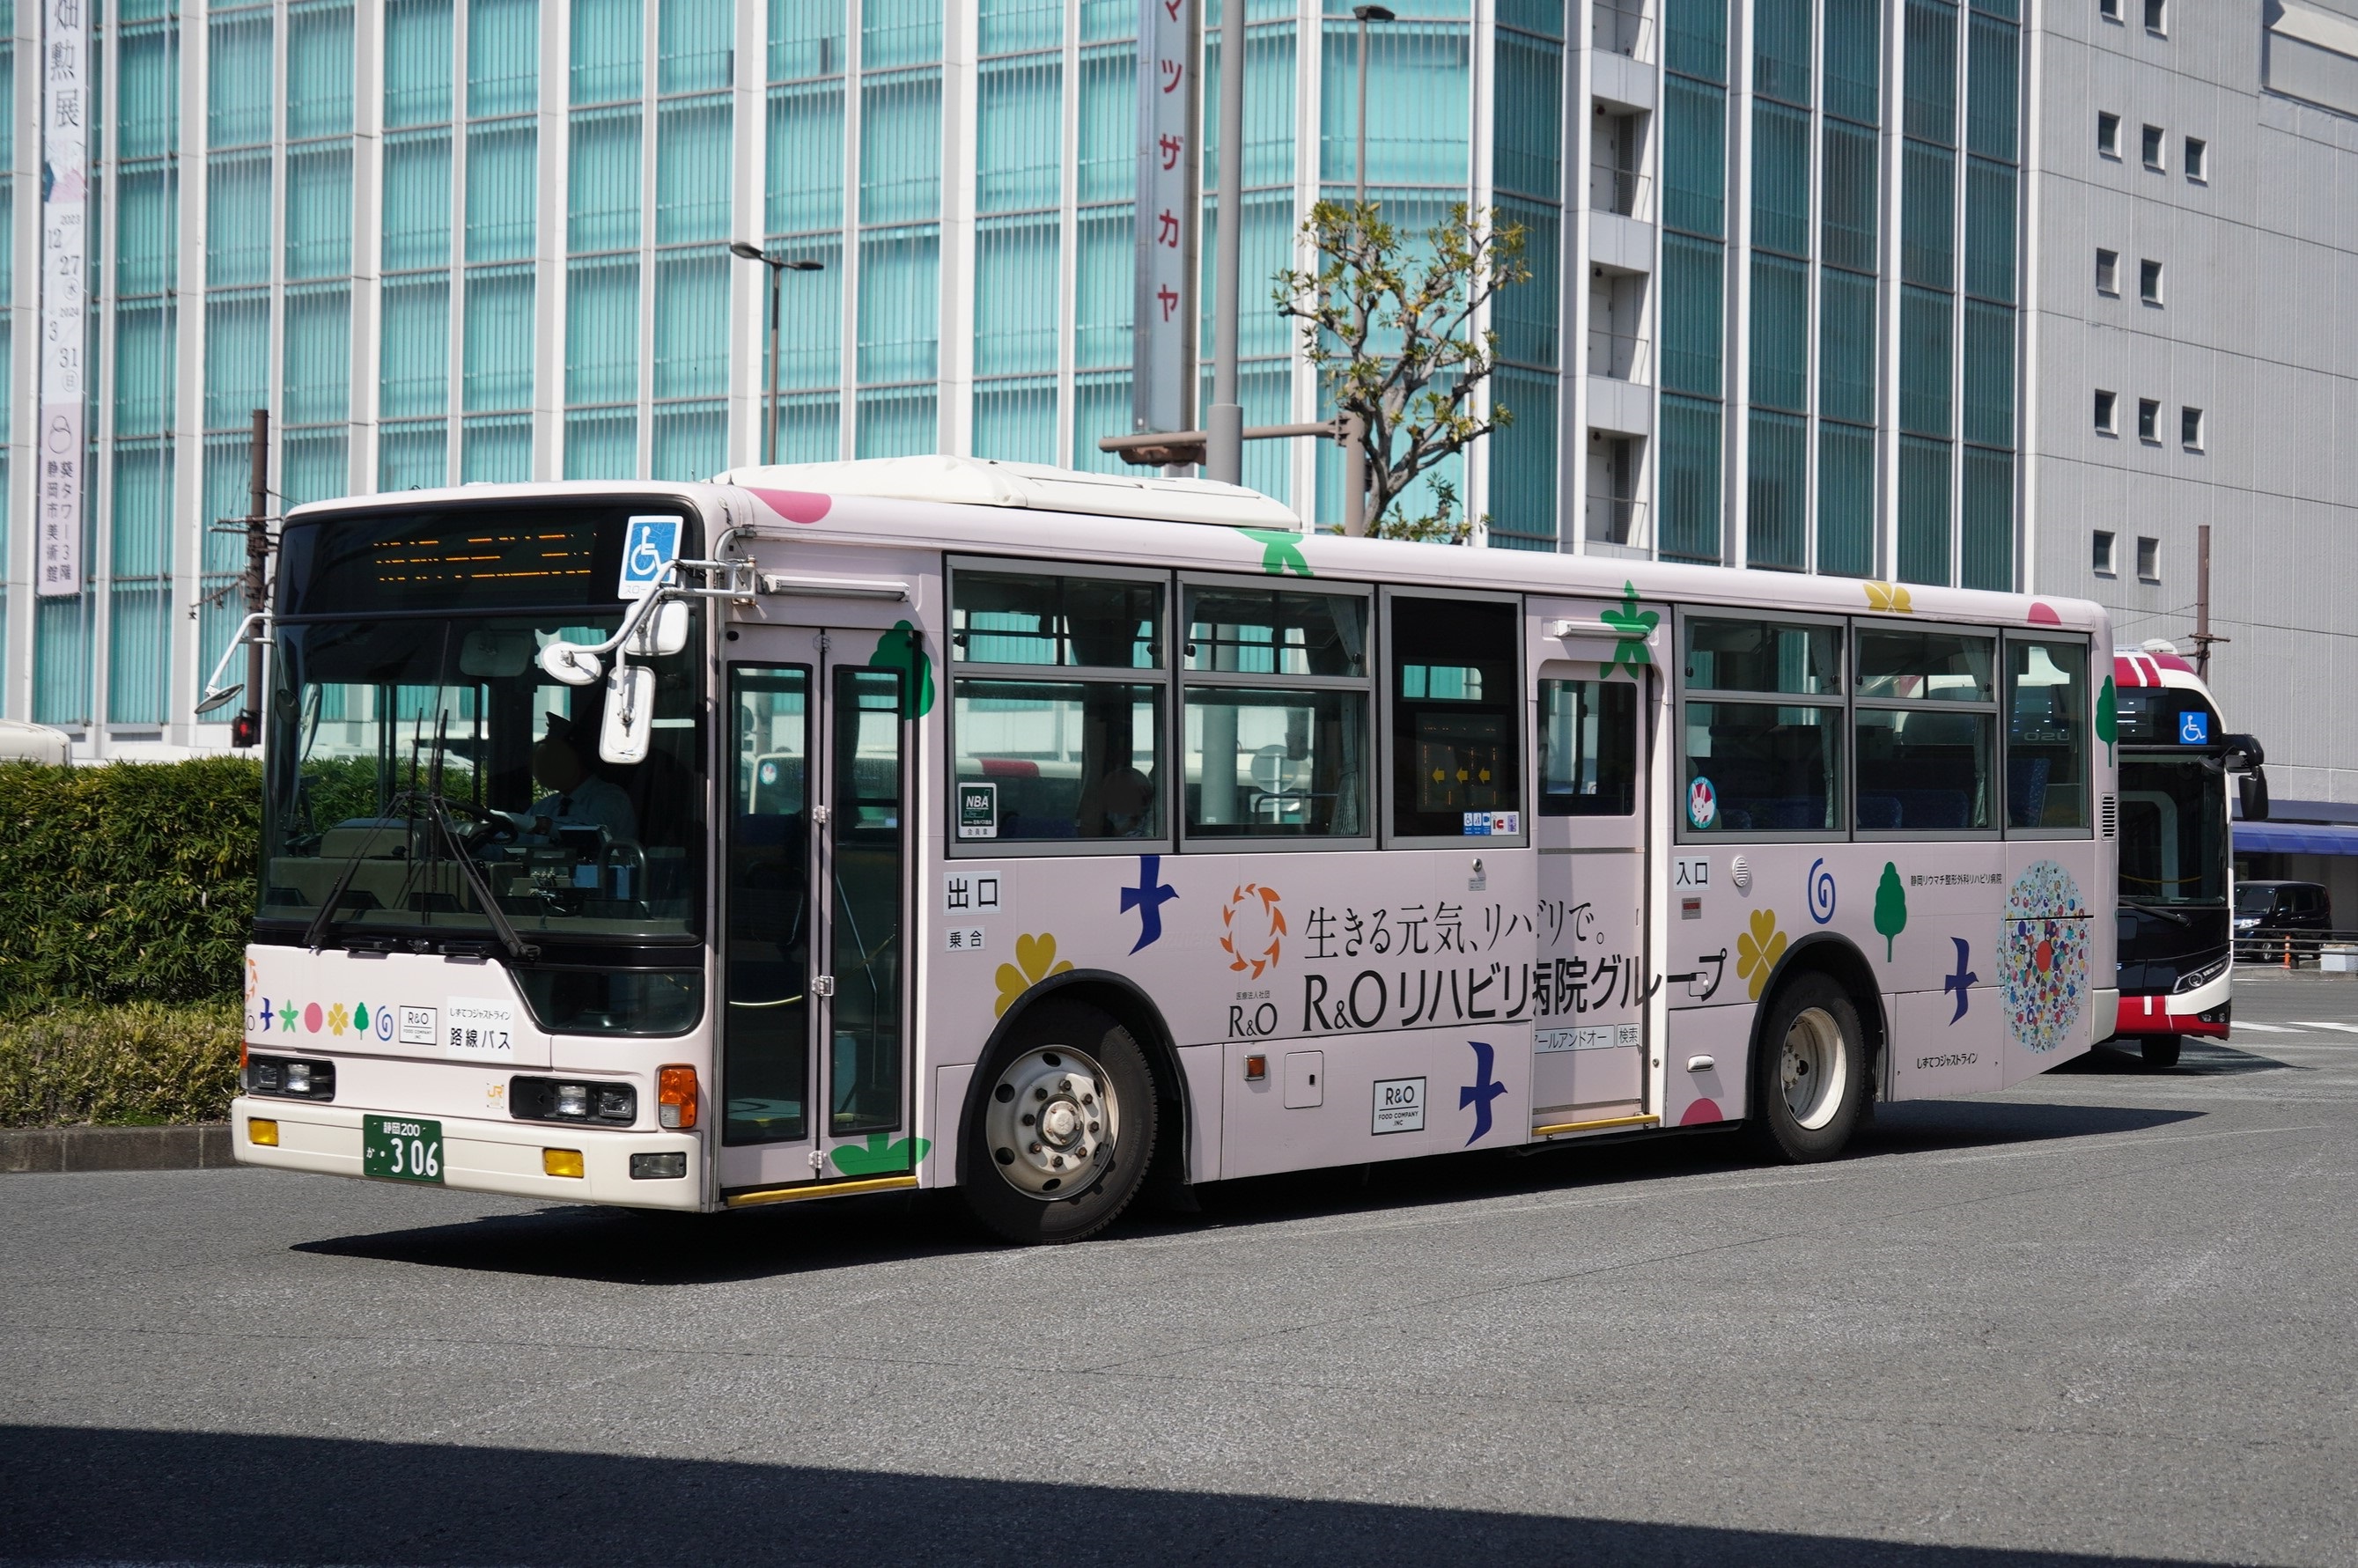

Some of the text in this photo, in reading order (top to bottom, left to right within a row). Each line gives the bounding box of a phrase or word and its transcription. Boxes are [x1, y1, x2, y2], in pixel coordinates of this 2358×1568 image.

[1157, 0, 1183, 322] マツザカヤ
[966, 795, 989, 808] NBA
[1676, 862, 1708, 886] 入口
[948, 878, 998, 909] 出口
[949, 930, 983, 949] 乗合
[408, 1012, 429, 1025] R&O
[1227, 1002, 1278, 1037] R&O
[450, 1027, 511, 1049] 路線バス
[1618, 1027, 1639, 1043] 検索
[1917, 1053, 1979, 1069] しずてつジャストライン
[488, 1086, 503, 1099] JR
[1385, 1086, 1415, 1106] R&O
[1393, 1110, 1419, 1119] COMPANY
